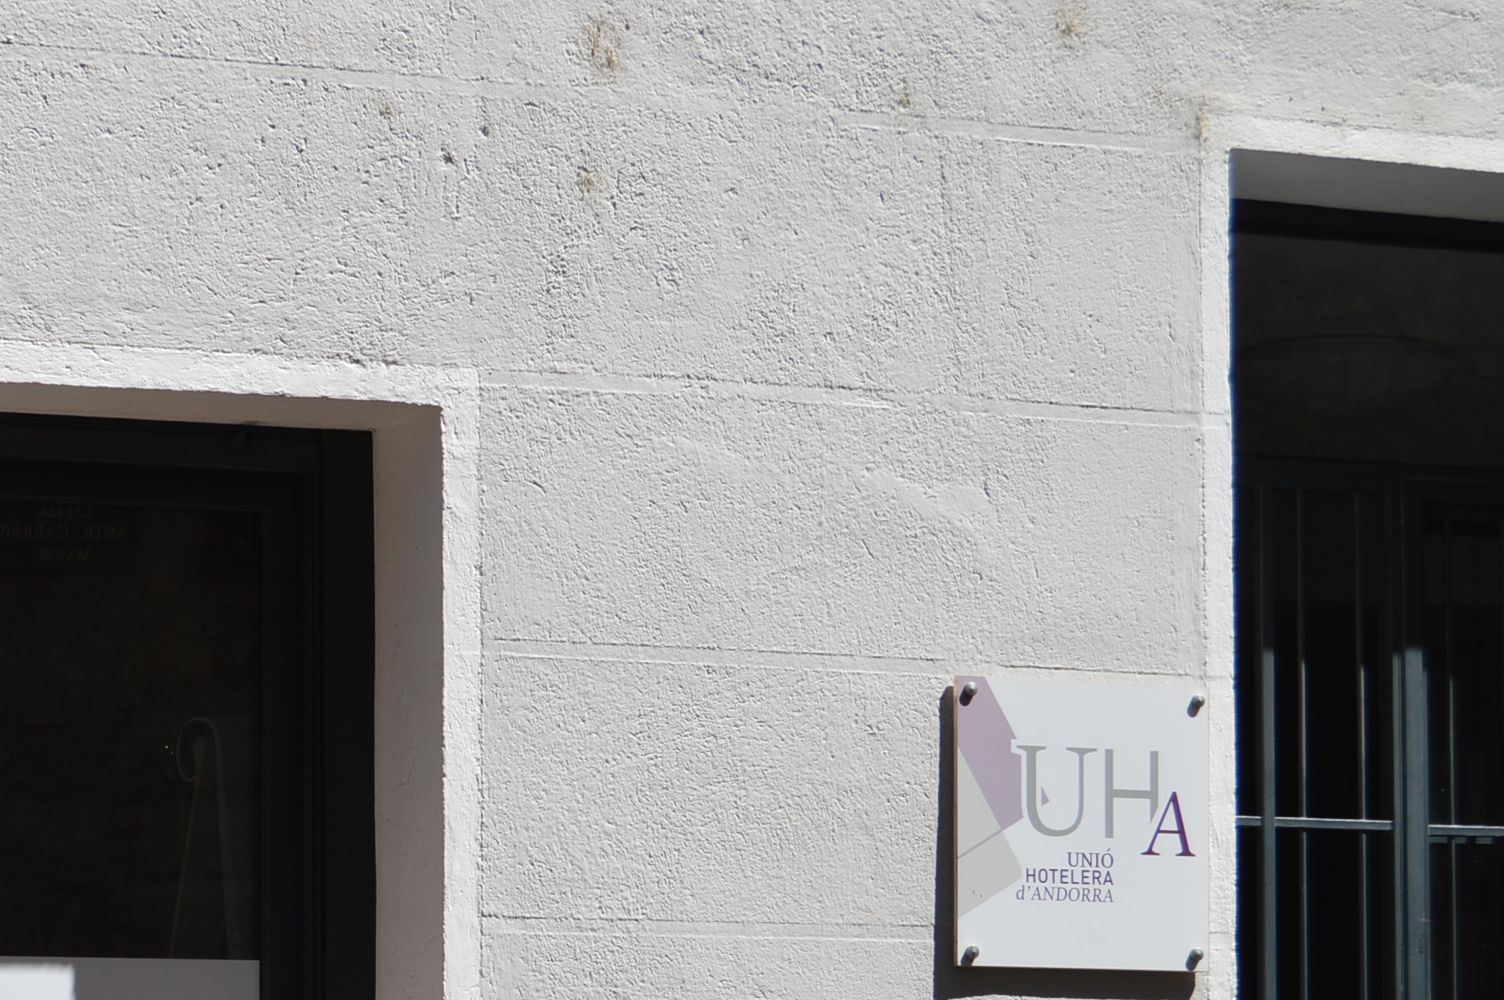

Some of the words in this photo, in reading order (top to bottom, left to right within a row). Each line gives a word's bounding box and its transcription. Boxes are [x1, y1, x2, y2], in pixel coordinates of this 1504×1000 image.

[1015, 744, 1197, 858] UHA
[1067, 848, 1114, 868] UNIÓ
[1025, 867, 1115, 886] HOTELERA
[1015, 886, 1114, 903] d'ANDORRA
